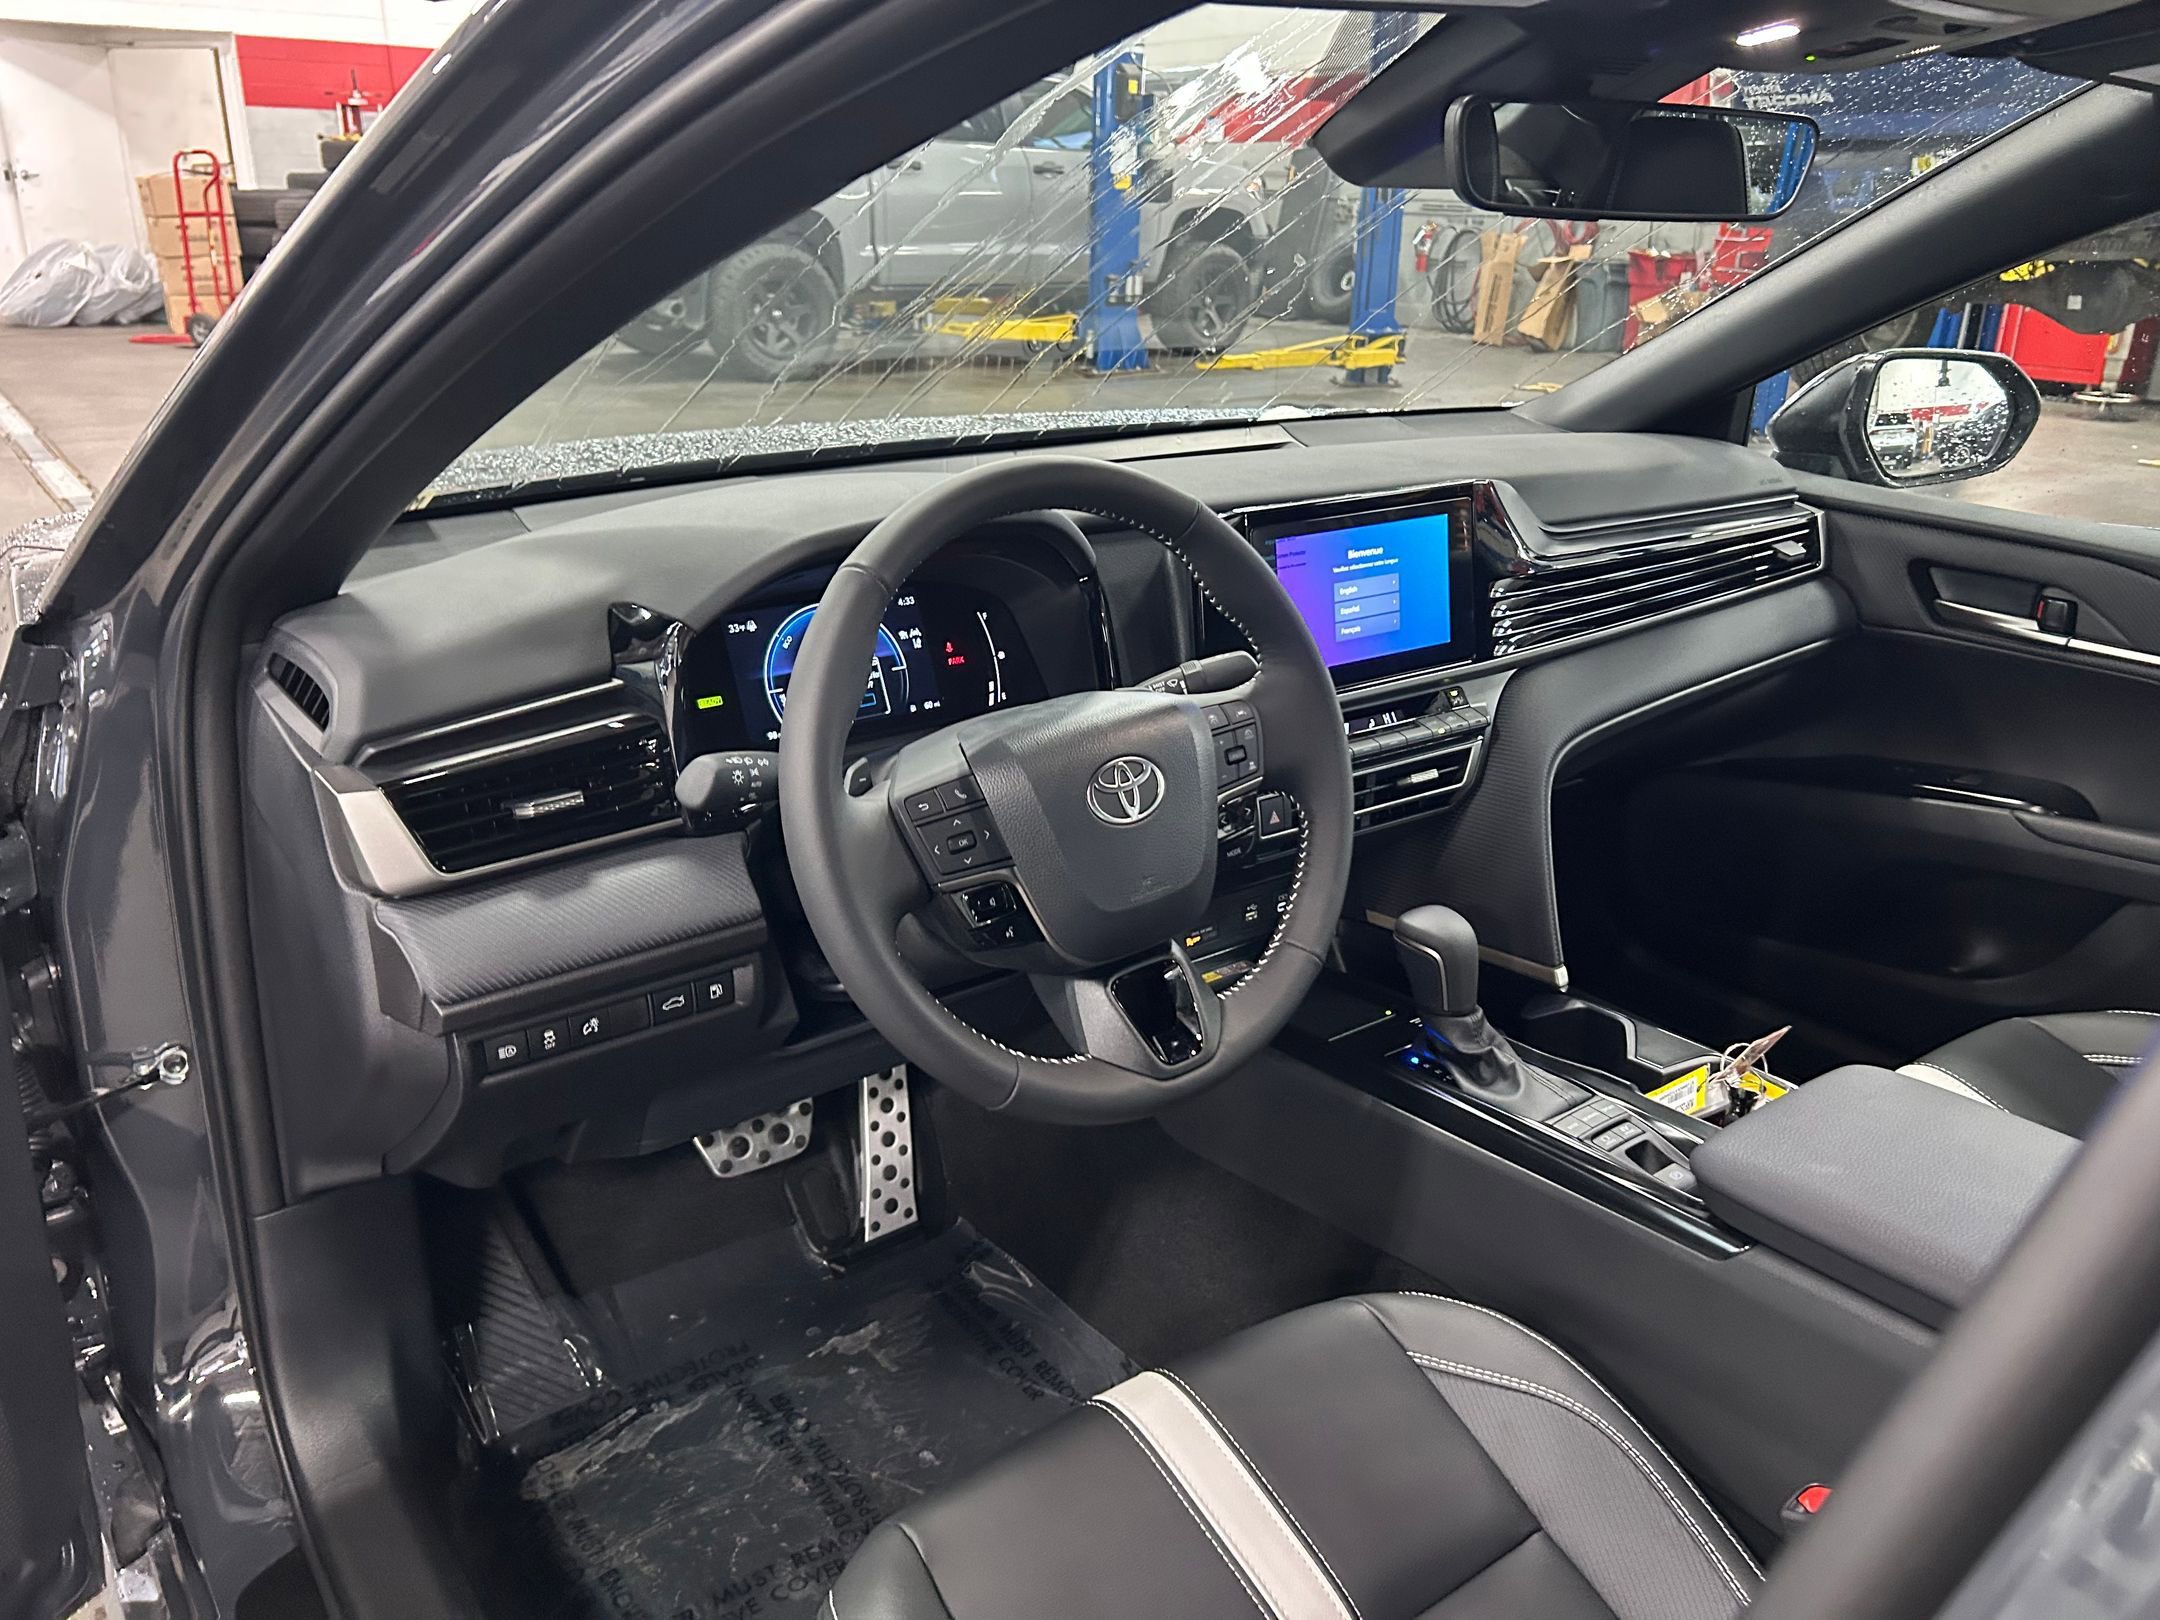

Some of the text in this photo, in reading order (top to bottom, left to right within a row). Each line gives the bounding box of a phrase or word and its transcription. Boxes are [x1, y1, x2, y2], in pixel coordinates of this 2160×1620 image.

[1743, 91, 1834, 110] TACOMA
[1347, 547, 1384, 559] Bienvenue
[1340, 586, 1358, 595] English
[898, 596, 915, 606] 4:33
[1382, 711, 1397, 725] HI
[958, 838, 968, 847] OK
[1226, 847, 1241, 857] MODE
[1000, 1321, 1038, 1357] MUST
[999, 1357, 1045, 1400] COVER
[803, 1472, 851, 1528] DEALER
[713, 1564, 777, 1607] MUST
[769, 1558, 847, 1601] COVER
